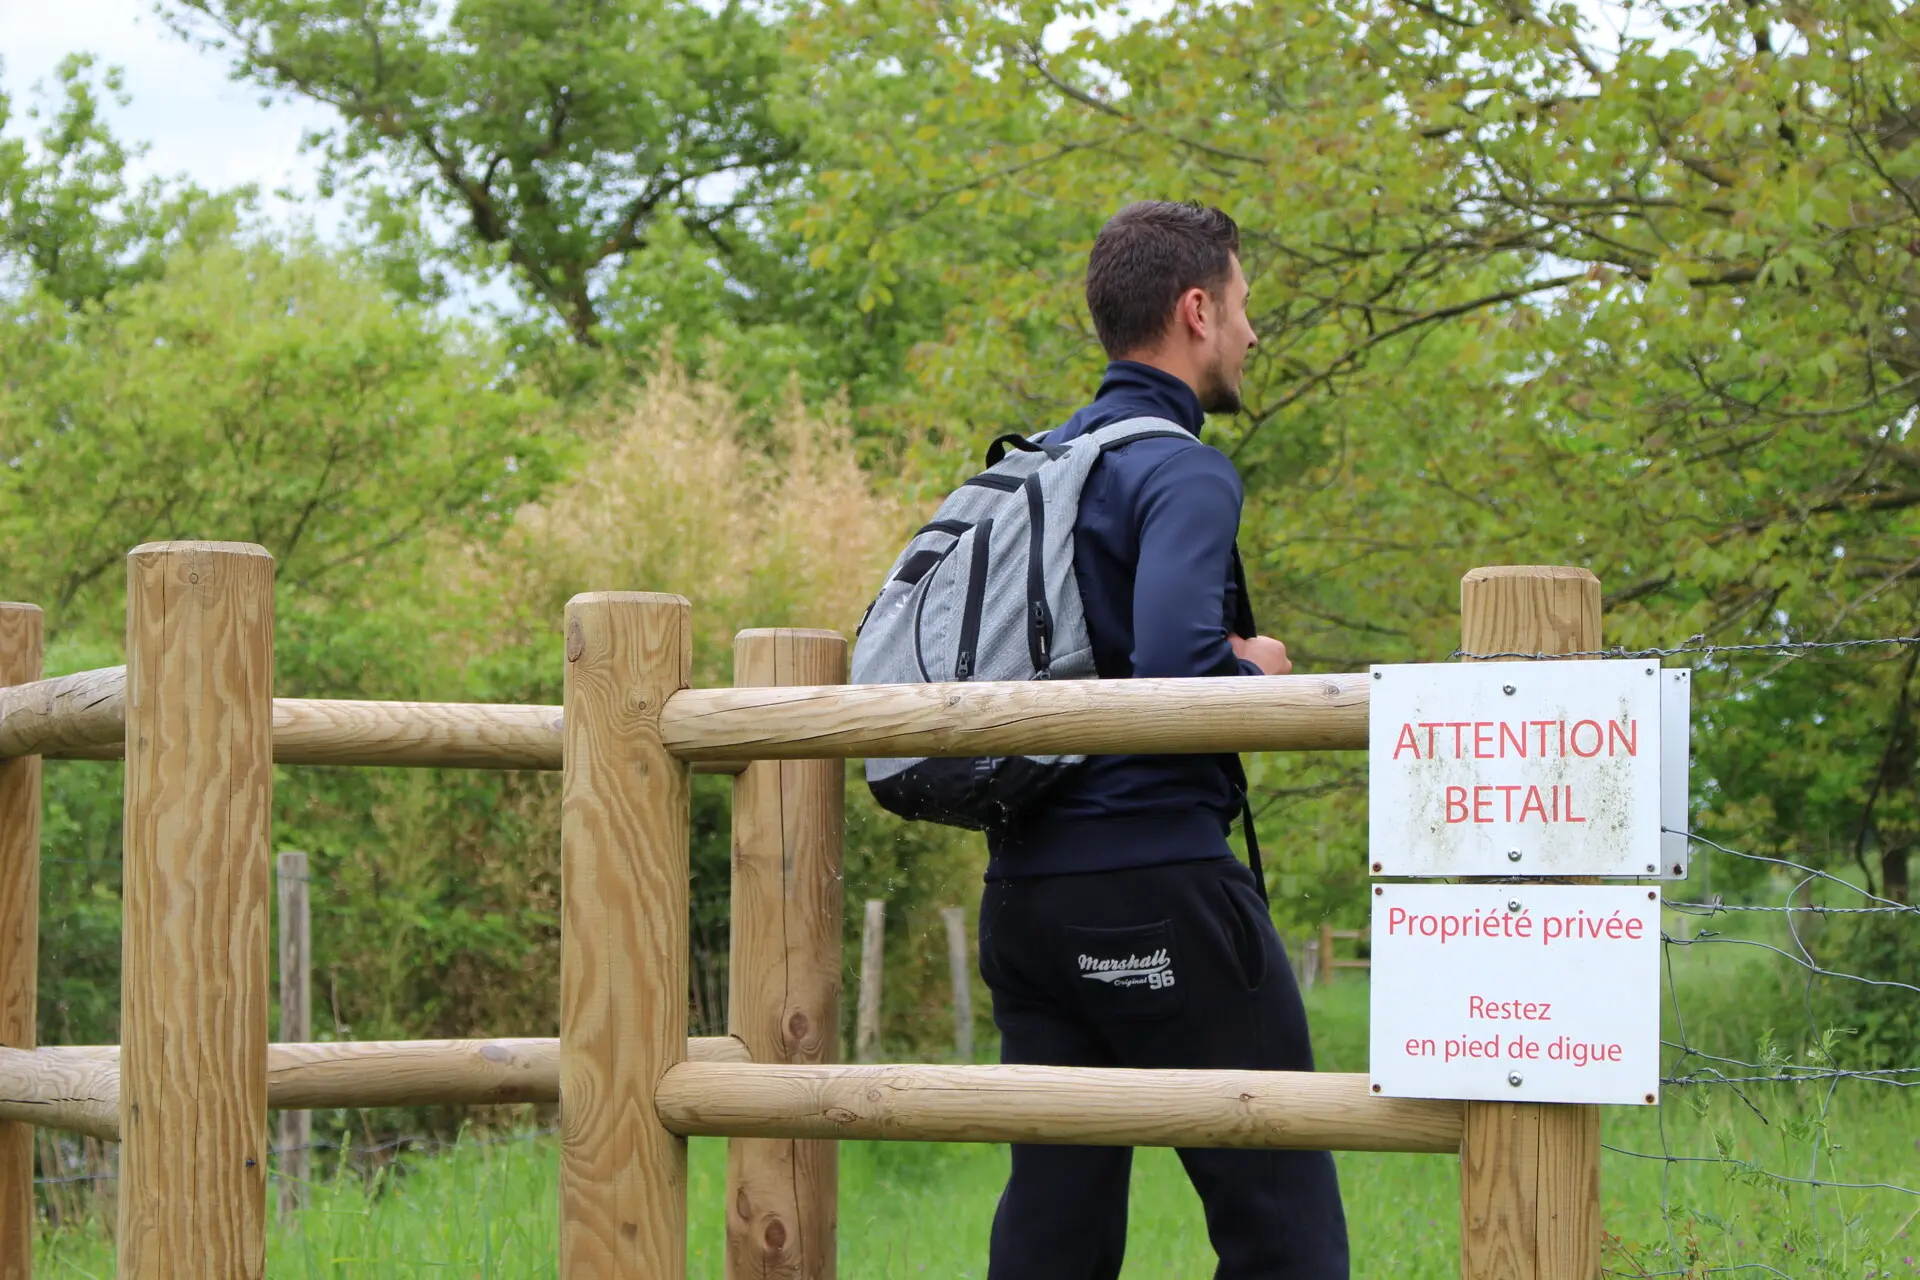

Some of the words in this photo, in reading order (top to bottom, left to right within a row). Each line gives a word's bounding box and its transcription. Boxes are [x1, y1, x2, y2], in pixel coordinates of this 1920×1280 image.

[1393, 720, 1637, 759] ATTENTION
[1445, 785, 1586, 823] BETAIL
[1389, 907, 1532, 943] Propriété
[1543, 910, 1643, 945] privée
[1078, 948, 1171, 970] Marshall
[1148, 969, 1175, 990] 96
[1469, 996, 1551, 1020] Restez
[1405, 1039, 1435, 1056] en
[1444, 1034, 1499, 1062] pied
[1507, 1035, 1539, 1059] de
[1547, 1037, 1622, 1067] digue
